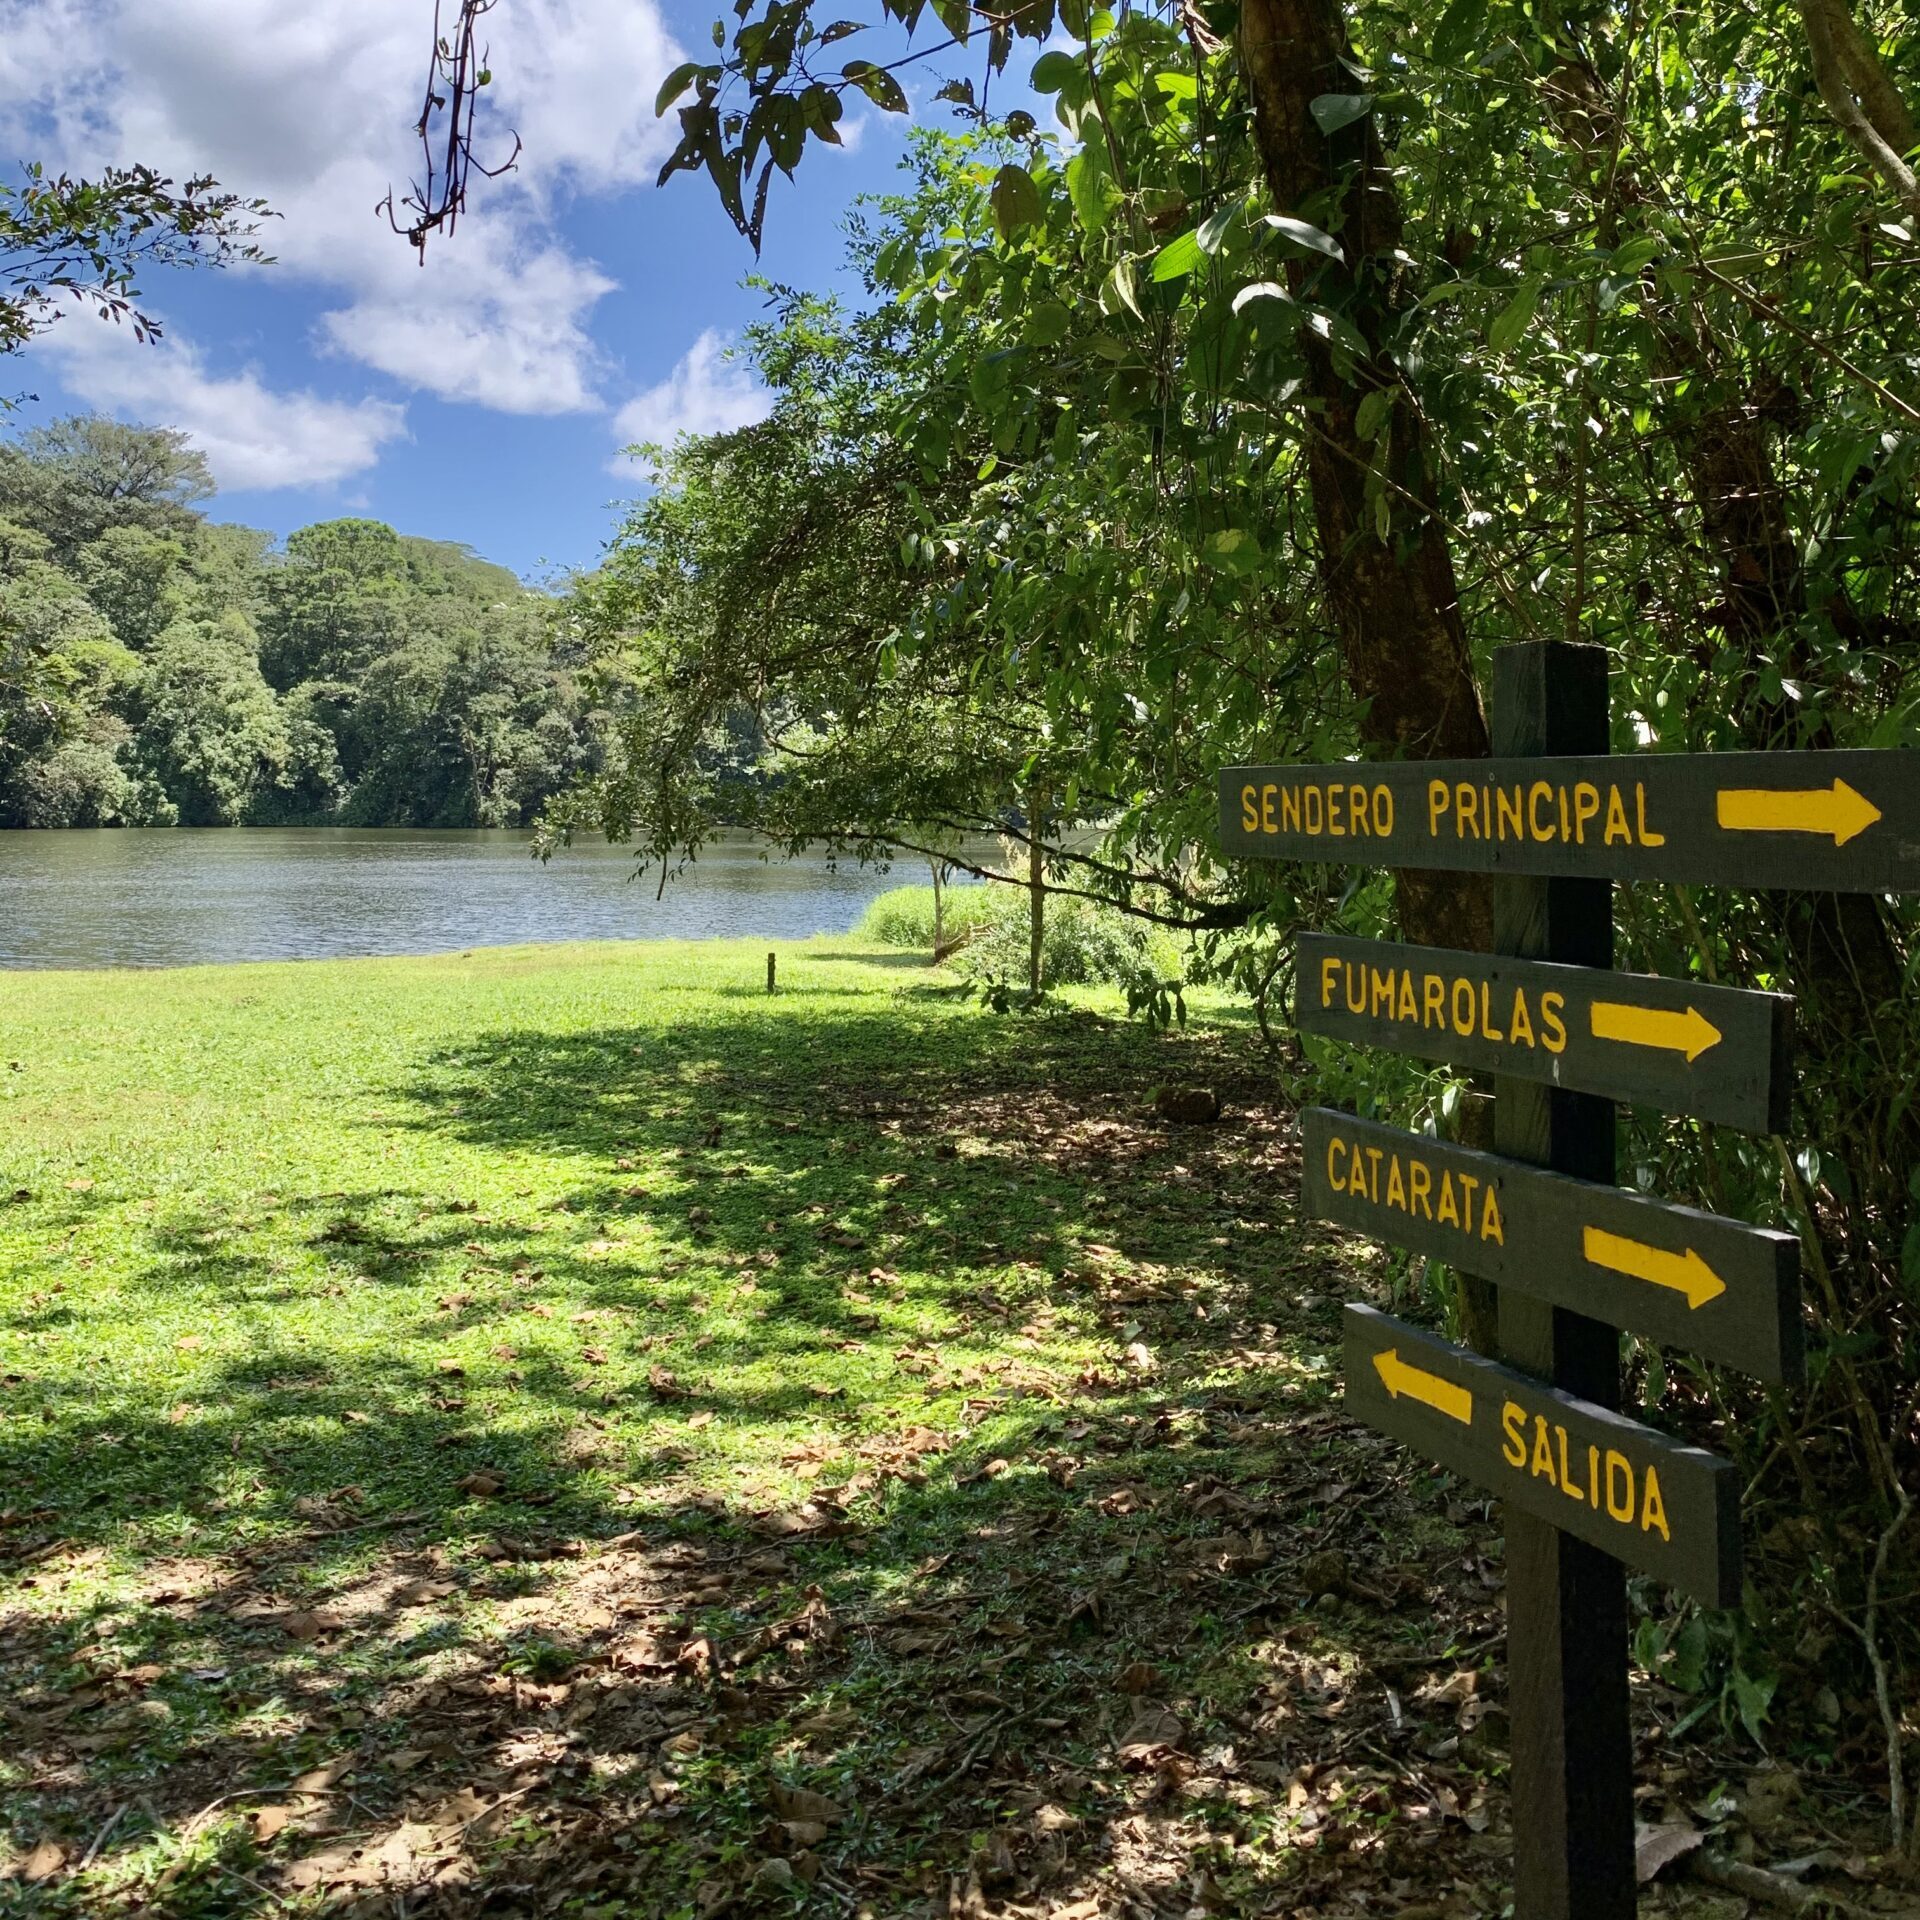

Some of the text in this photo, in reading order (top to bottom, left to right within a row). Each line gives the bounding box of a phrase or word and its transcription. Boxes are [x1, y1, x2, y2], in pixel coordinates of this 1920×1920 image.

[1241, 779, 1666, 848] SENDERO PRINCIPAL
[1321, 957, 1567, 1054] FUMAROLAS
[1327, 1137, 1504, 1246] CATARATA
[1502, 1400, 1670, 1542] SALIDA
